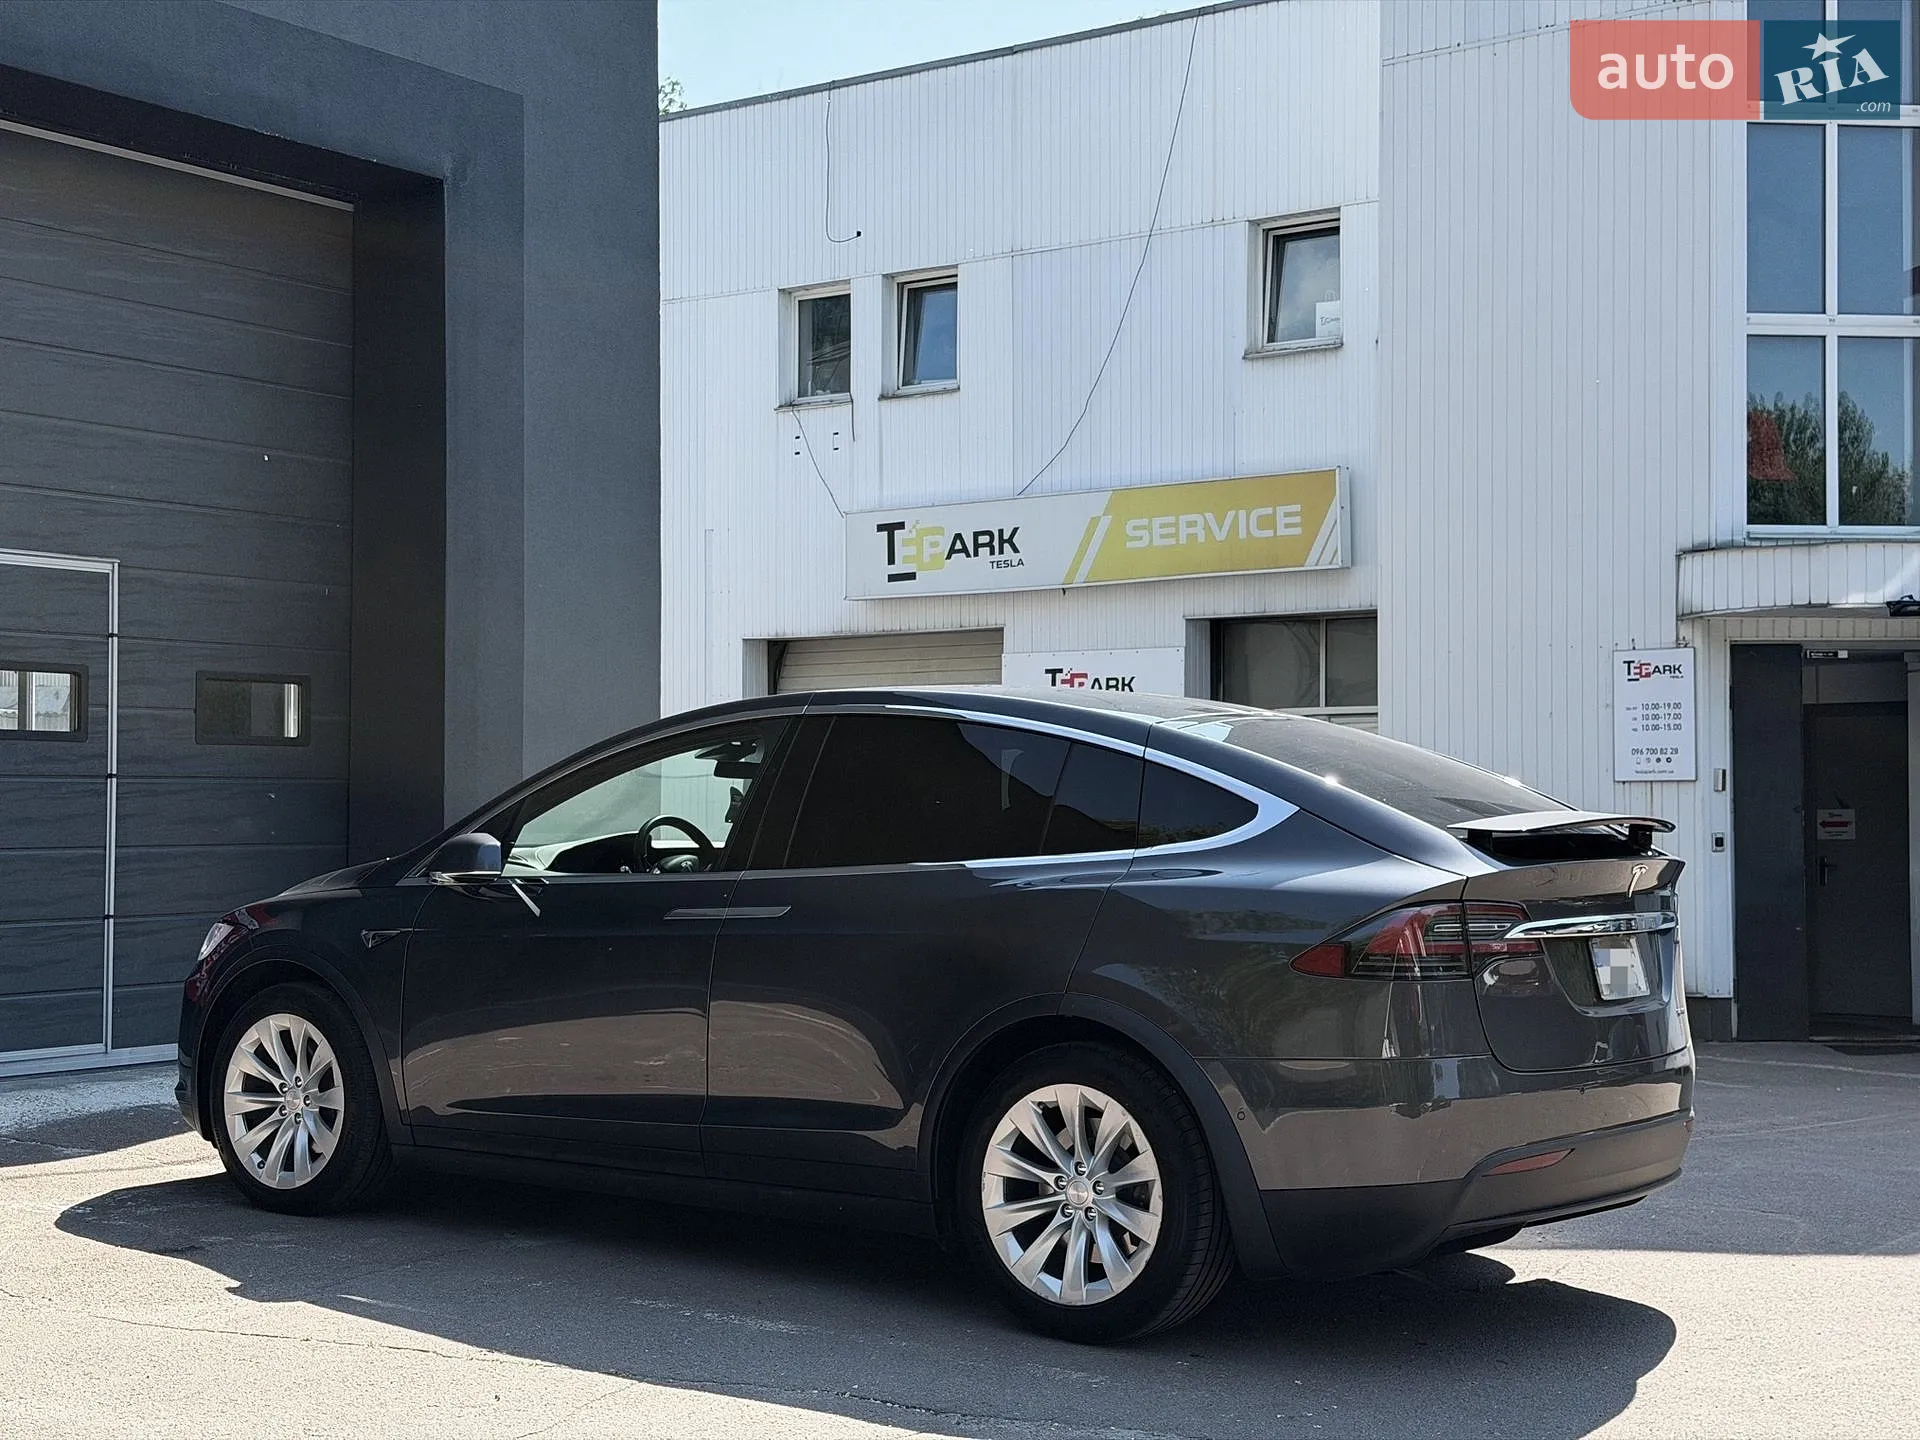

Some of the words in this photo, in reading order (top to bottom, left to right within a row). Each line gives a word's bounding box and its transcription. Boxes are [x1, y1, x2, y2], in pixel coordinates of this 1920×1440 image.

[1125, 503, 1303, 549] SERVICE
[989, 558, 1025, 570] TESLA
[1645, 747, 1658, 755] 700
